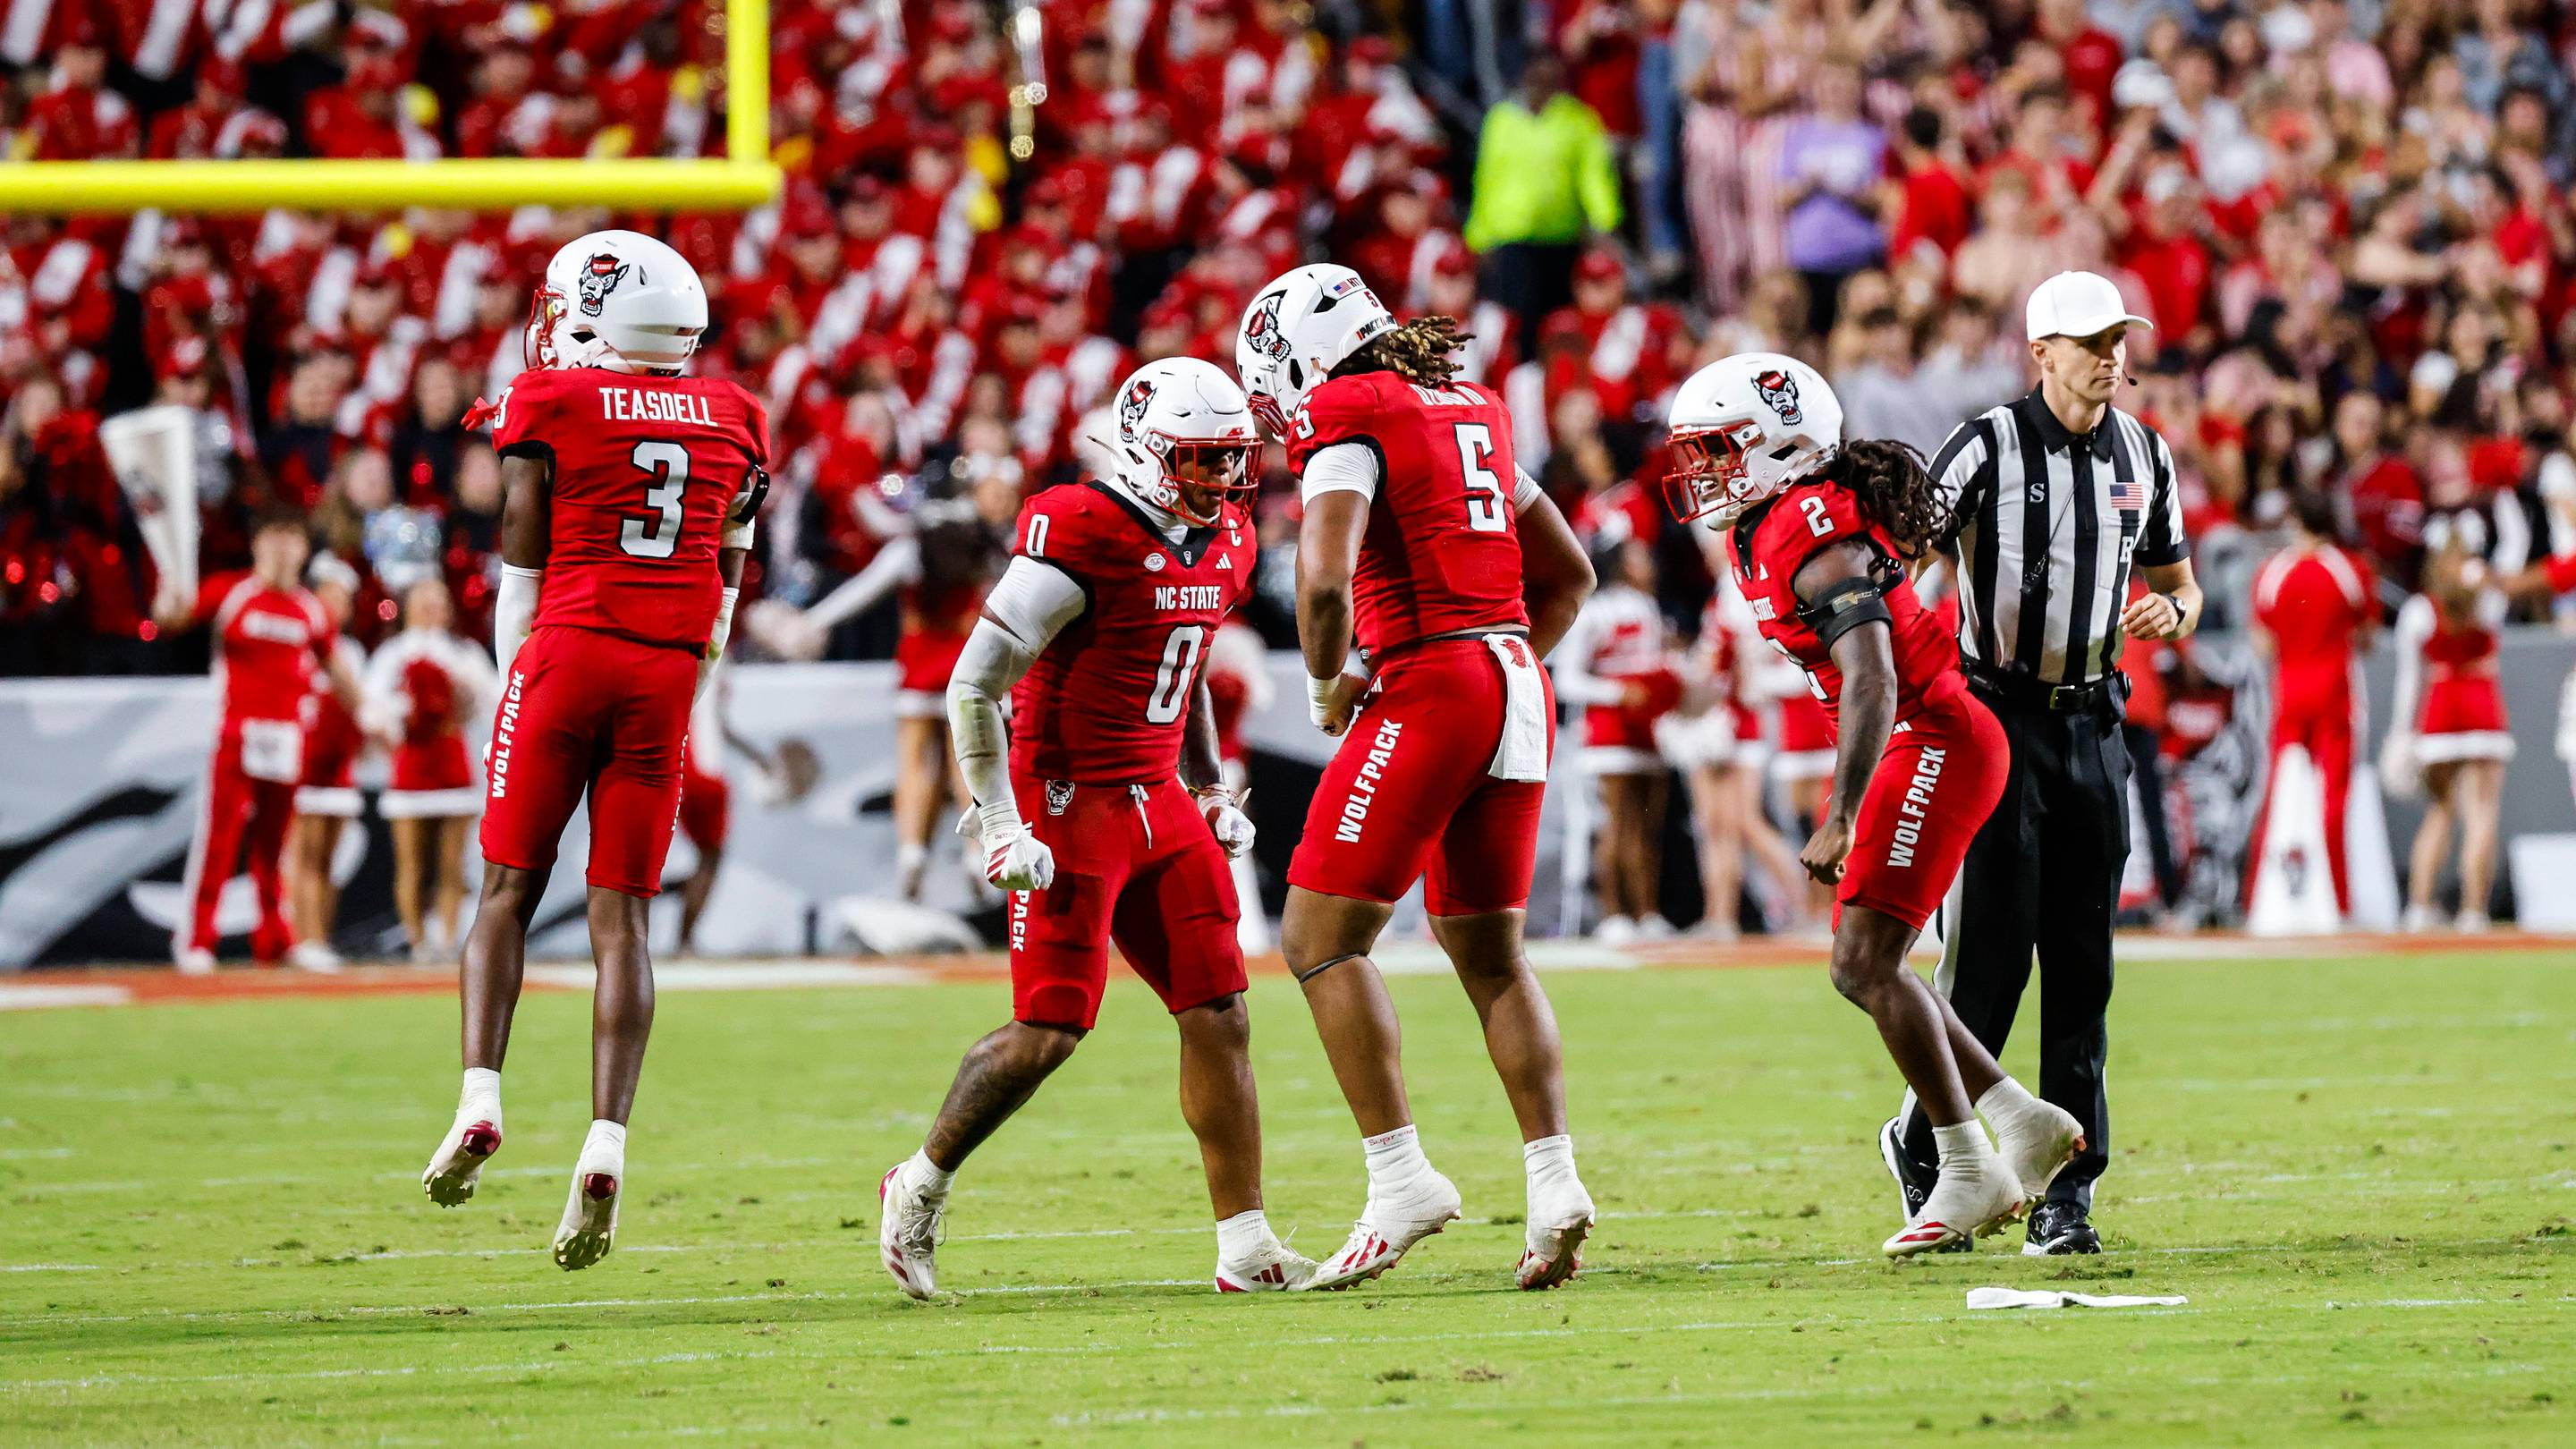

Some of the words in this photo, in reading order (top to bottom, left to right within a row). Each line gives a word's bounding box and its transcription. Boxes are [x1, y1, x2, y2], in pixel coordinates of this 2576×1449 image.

[1364, 291, 1379, 309] 5
[494, 386, 514, 429] 3
[598, 387, 719, 427] TEASDELL
[1295, 394, 1315, 440] 5
[620, 440, 691, 558] 3
[1454, 423, 1508, 533] 5
[2029, 483, 2045, 503] S
[1026, 514, 1050, 557] 0
[1227, 518, 1242, 547] C
[1799, 496, 1835, 538] 2
[2119, 536, 2135, 563] R
[1155, 586, 1177, 610] NC
[1179, 586, 1222, 610] STATE
[1146, 625, 1205, 724] 0
[491, 669, 526, 800] WOLFPACK
[1335, 718, 1403, 843] WOLFPACK
[1886, 745, 1947, 868] WOLFPACK
[1013, 889, 1030, 953] PACK
